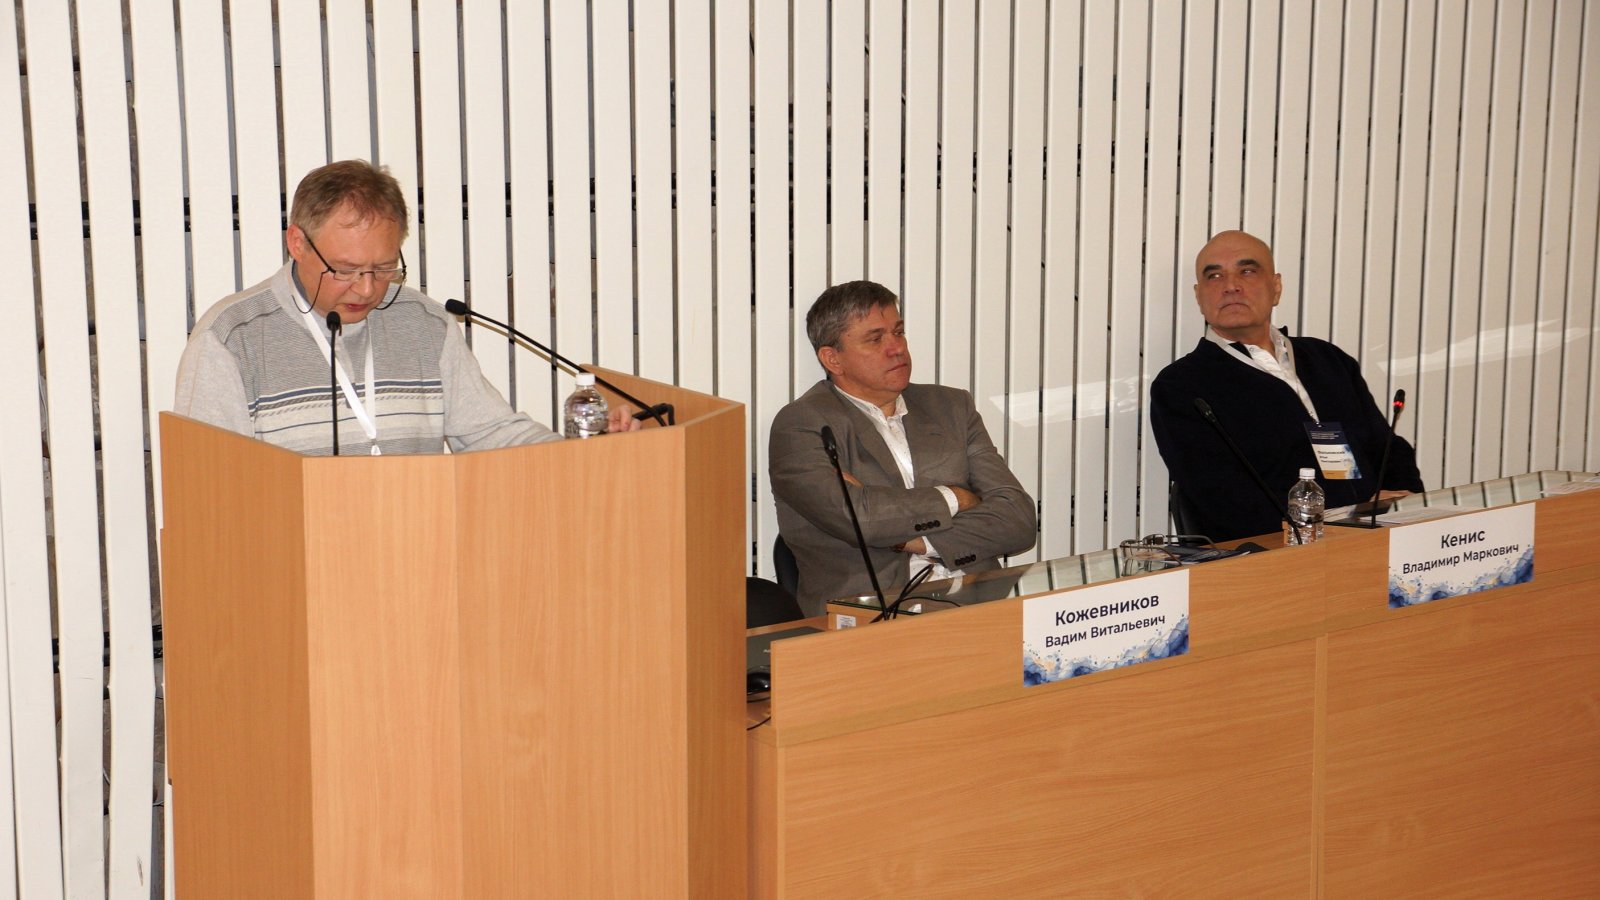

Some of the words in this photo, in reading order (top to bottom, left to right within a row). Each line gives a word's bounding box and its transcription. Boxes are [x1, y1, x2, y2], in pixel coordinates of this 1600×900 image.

[1441, 530, 1486, 548] Кенис
[1402, 554, 1460, 575] Владимир
[1463, 544, 1519, 562] Маркович
[1055, 595, 1159, 626] Кожевников
[1045, 631, 1087, 648] Вадим
[1091, 615, 1165, 638] Витальевич
